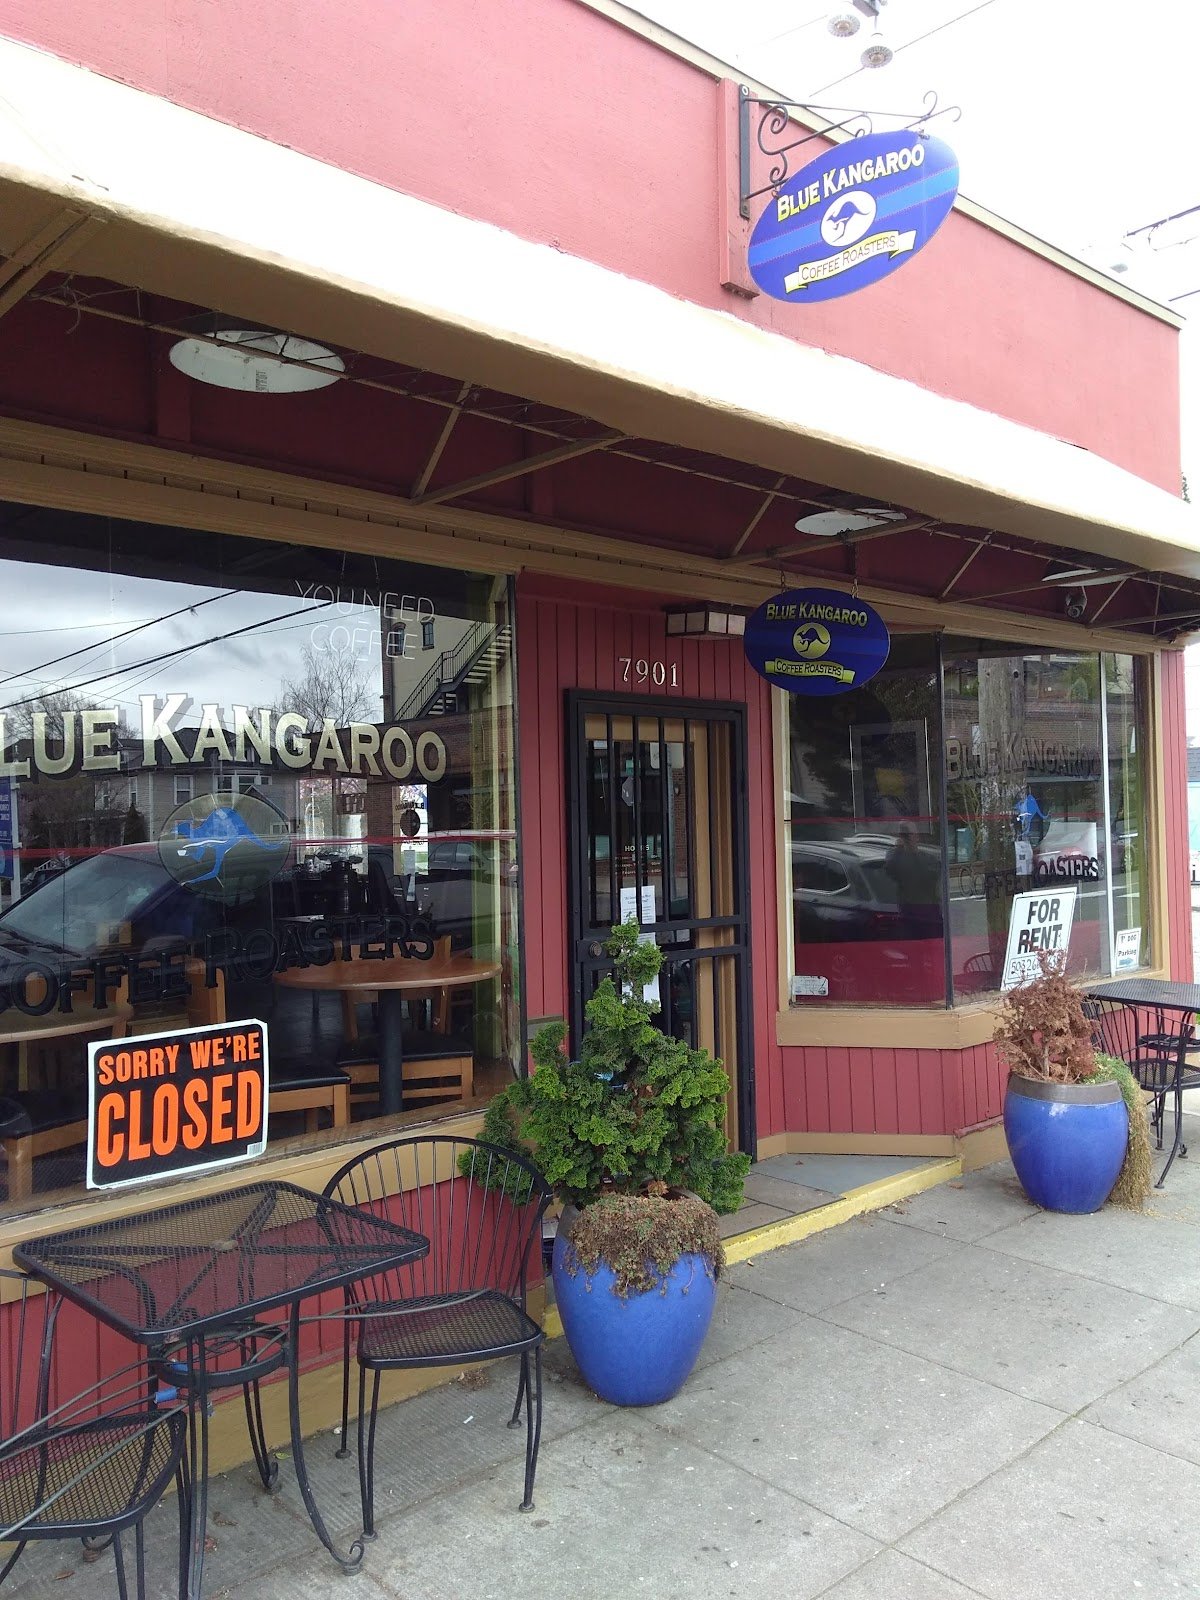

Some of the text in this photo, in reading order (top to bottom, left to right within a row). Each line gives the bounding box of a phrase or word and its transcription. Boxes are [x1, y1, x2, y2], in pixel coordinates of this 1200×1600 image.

[778, 143, 926, 222] BLUE KANGAROO
[801, 235, 896, 281] COFFEE ROASTERS
[295, 580, 435, 623] YOU NEED
[767, 601, 868, 627] BLUE KANGAROO
[310, 624, 418, 660] COFFEE
[618, 656, 679, 688] 7901
[776, 660, 842, 677] COFFEE ROASTERS
[138, 693, 448, 784] KANGAROO
[624, 844, 650, 852] HOS
[1027, 898, 1061, 925] FOR
[1017, 924, 1063, 955] RENT
[0, 914, 435, 1017] OFFEE ROASTERS
[98, 1032, 261, 1086] SORRY WE'RE
[97, 1070, 262, 1167] CLOSED
